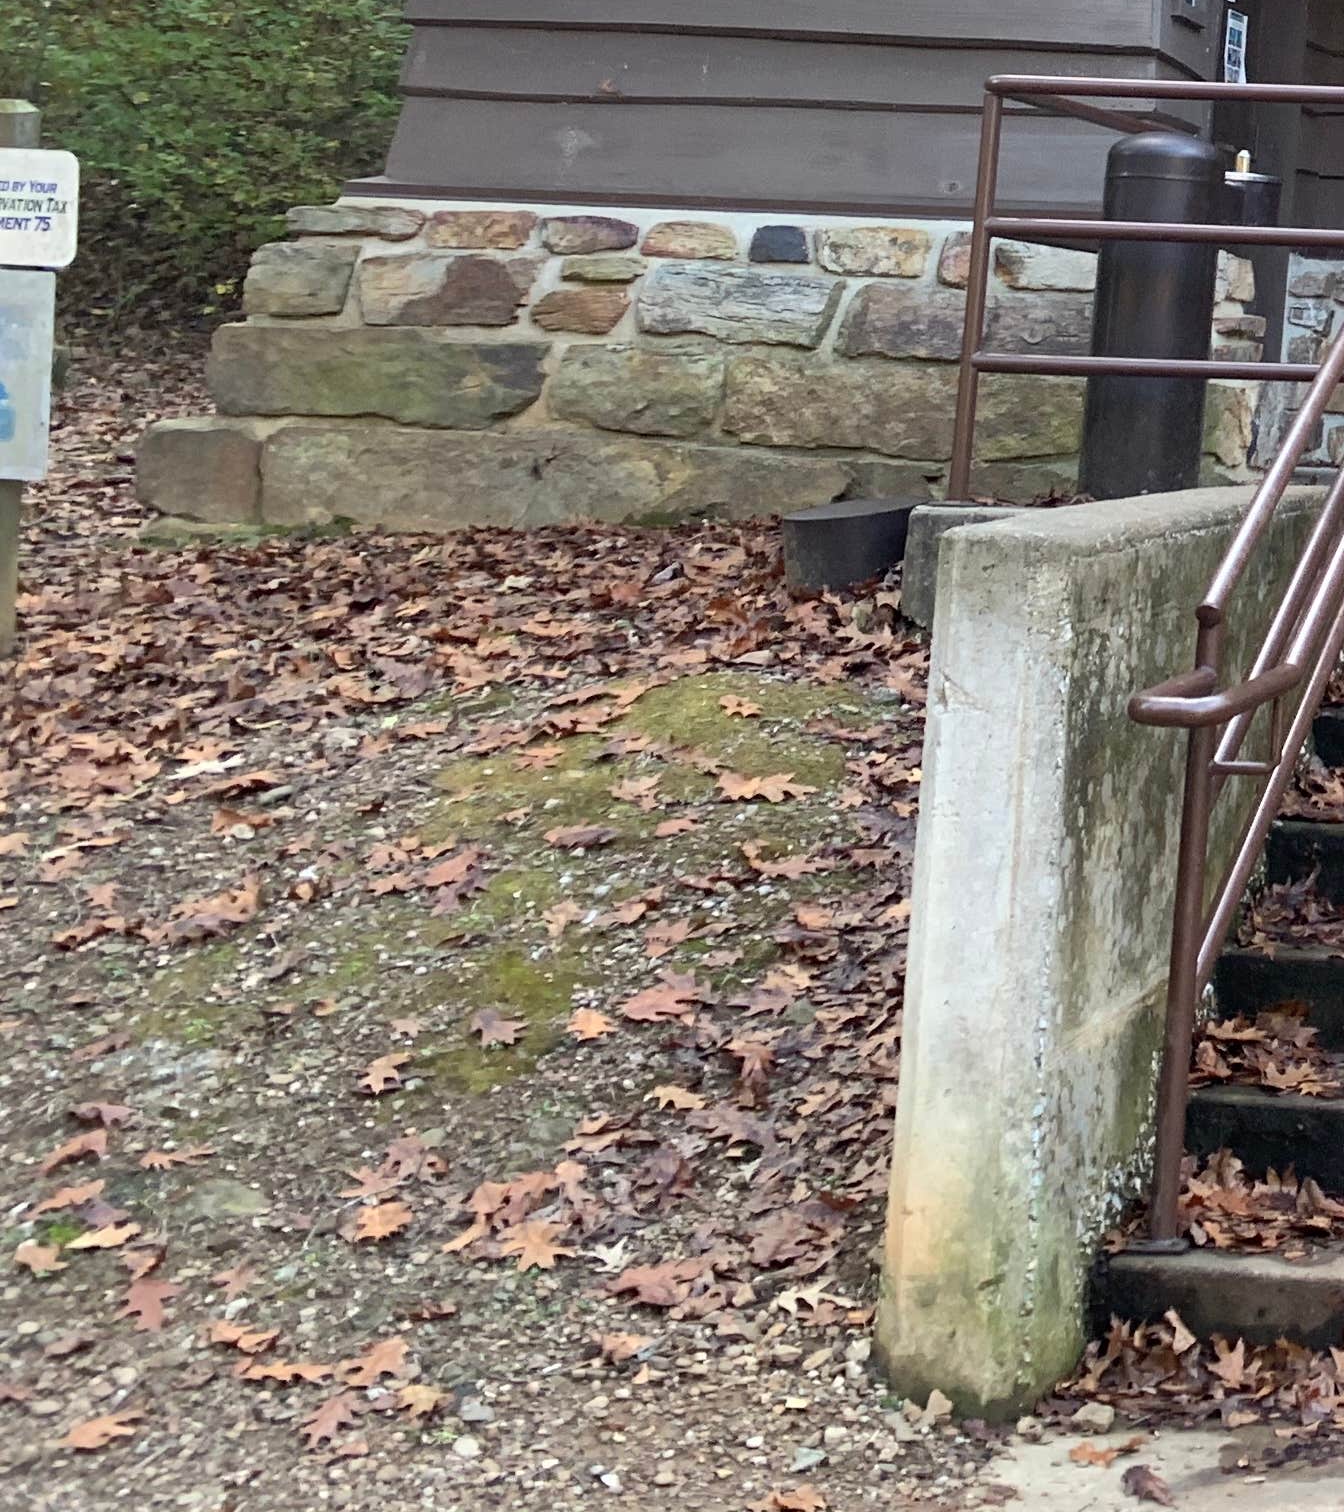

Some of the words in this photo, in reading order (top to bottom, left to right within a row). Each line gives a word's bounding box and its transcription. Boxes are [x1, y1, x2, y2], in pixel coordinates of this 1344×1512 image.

[12, 181, 26, 192] BY
[31, 180, 57, 194] YOUR
[47, 198, 67, 214] TAX
[34, 215, 51, 231] 75
